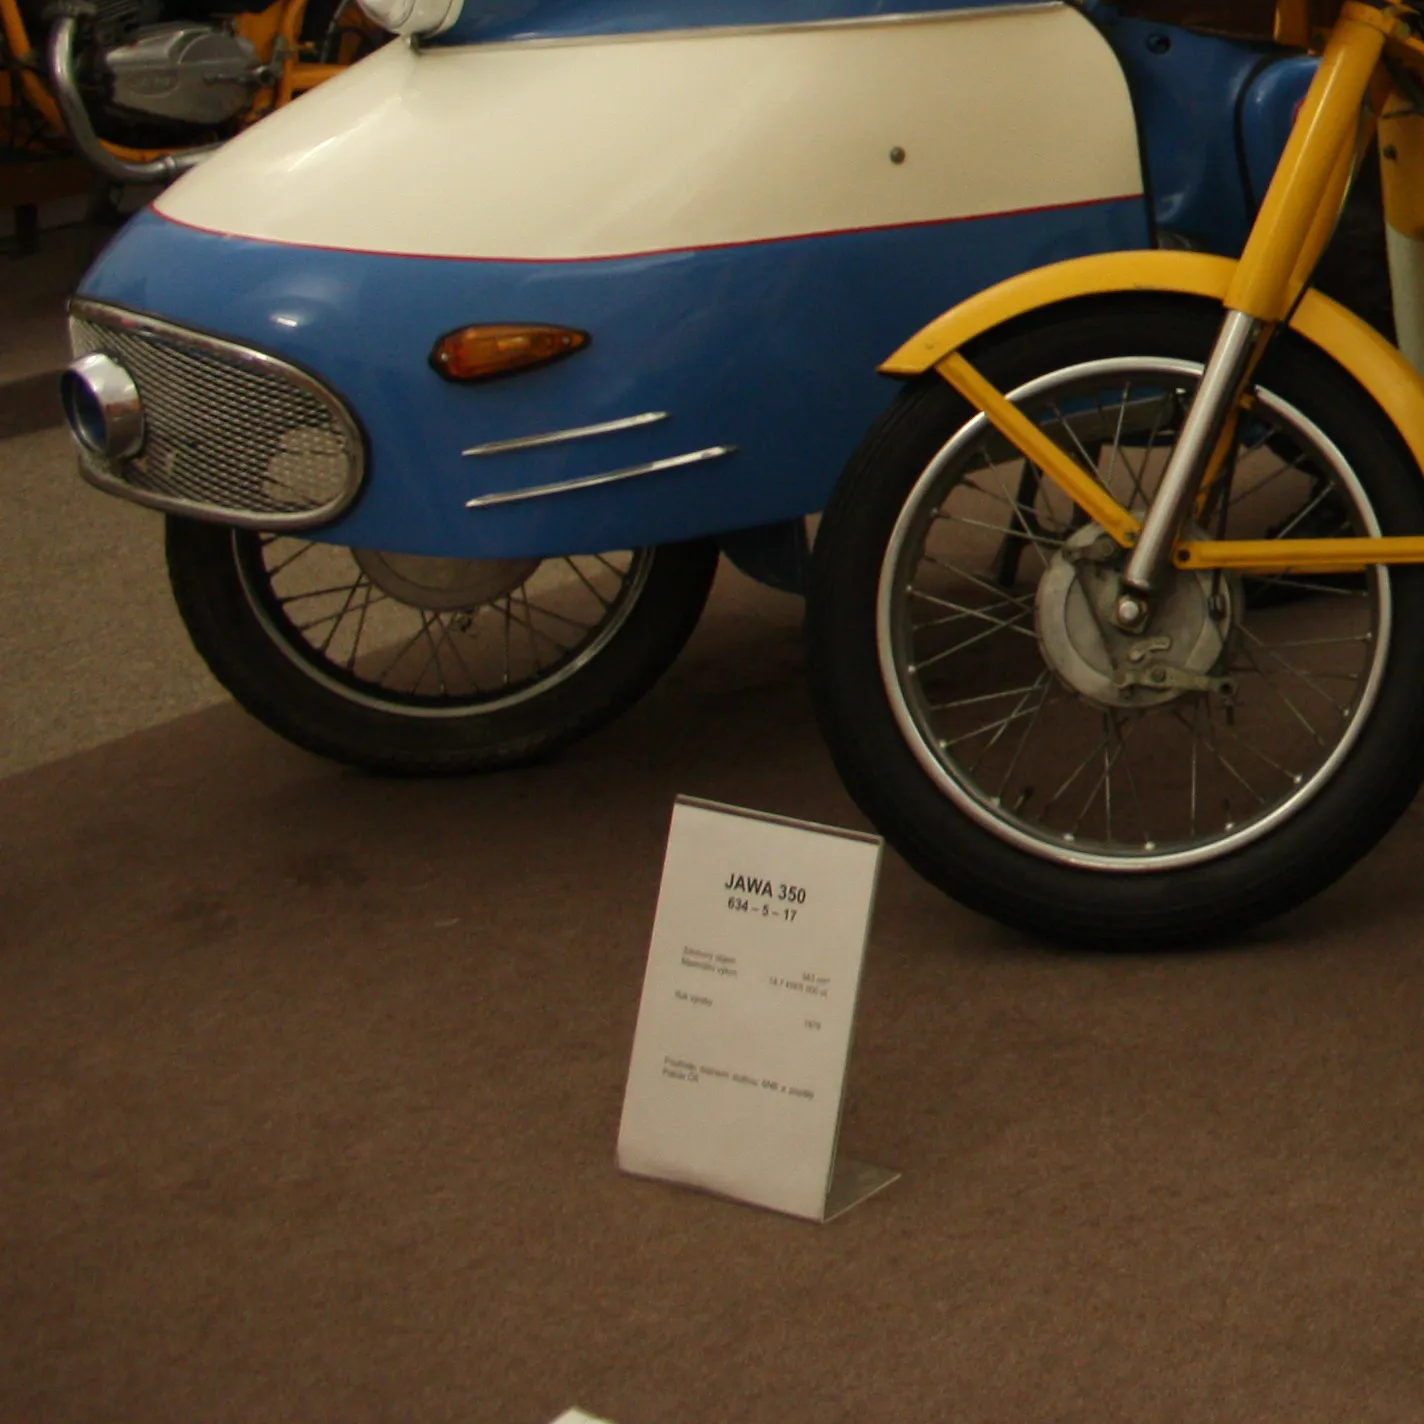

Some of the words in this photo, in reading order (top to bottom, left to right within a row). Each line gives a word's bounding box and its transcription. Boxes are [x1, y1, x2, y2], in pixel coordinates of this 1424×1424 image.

[725, 873, 773, 897] JAWA
[778, 884, 806, 904] 350
[728, 897, 748, 912] 634
[762, 904, 769, 917] 5
[784, 908, 797, 921] 17
